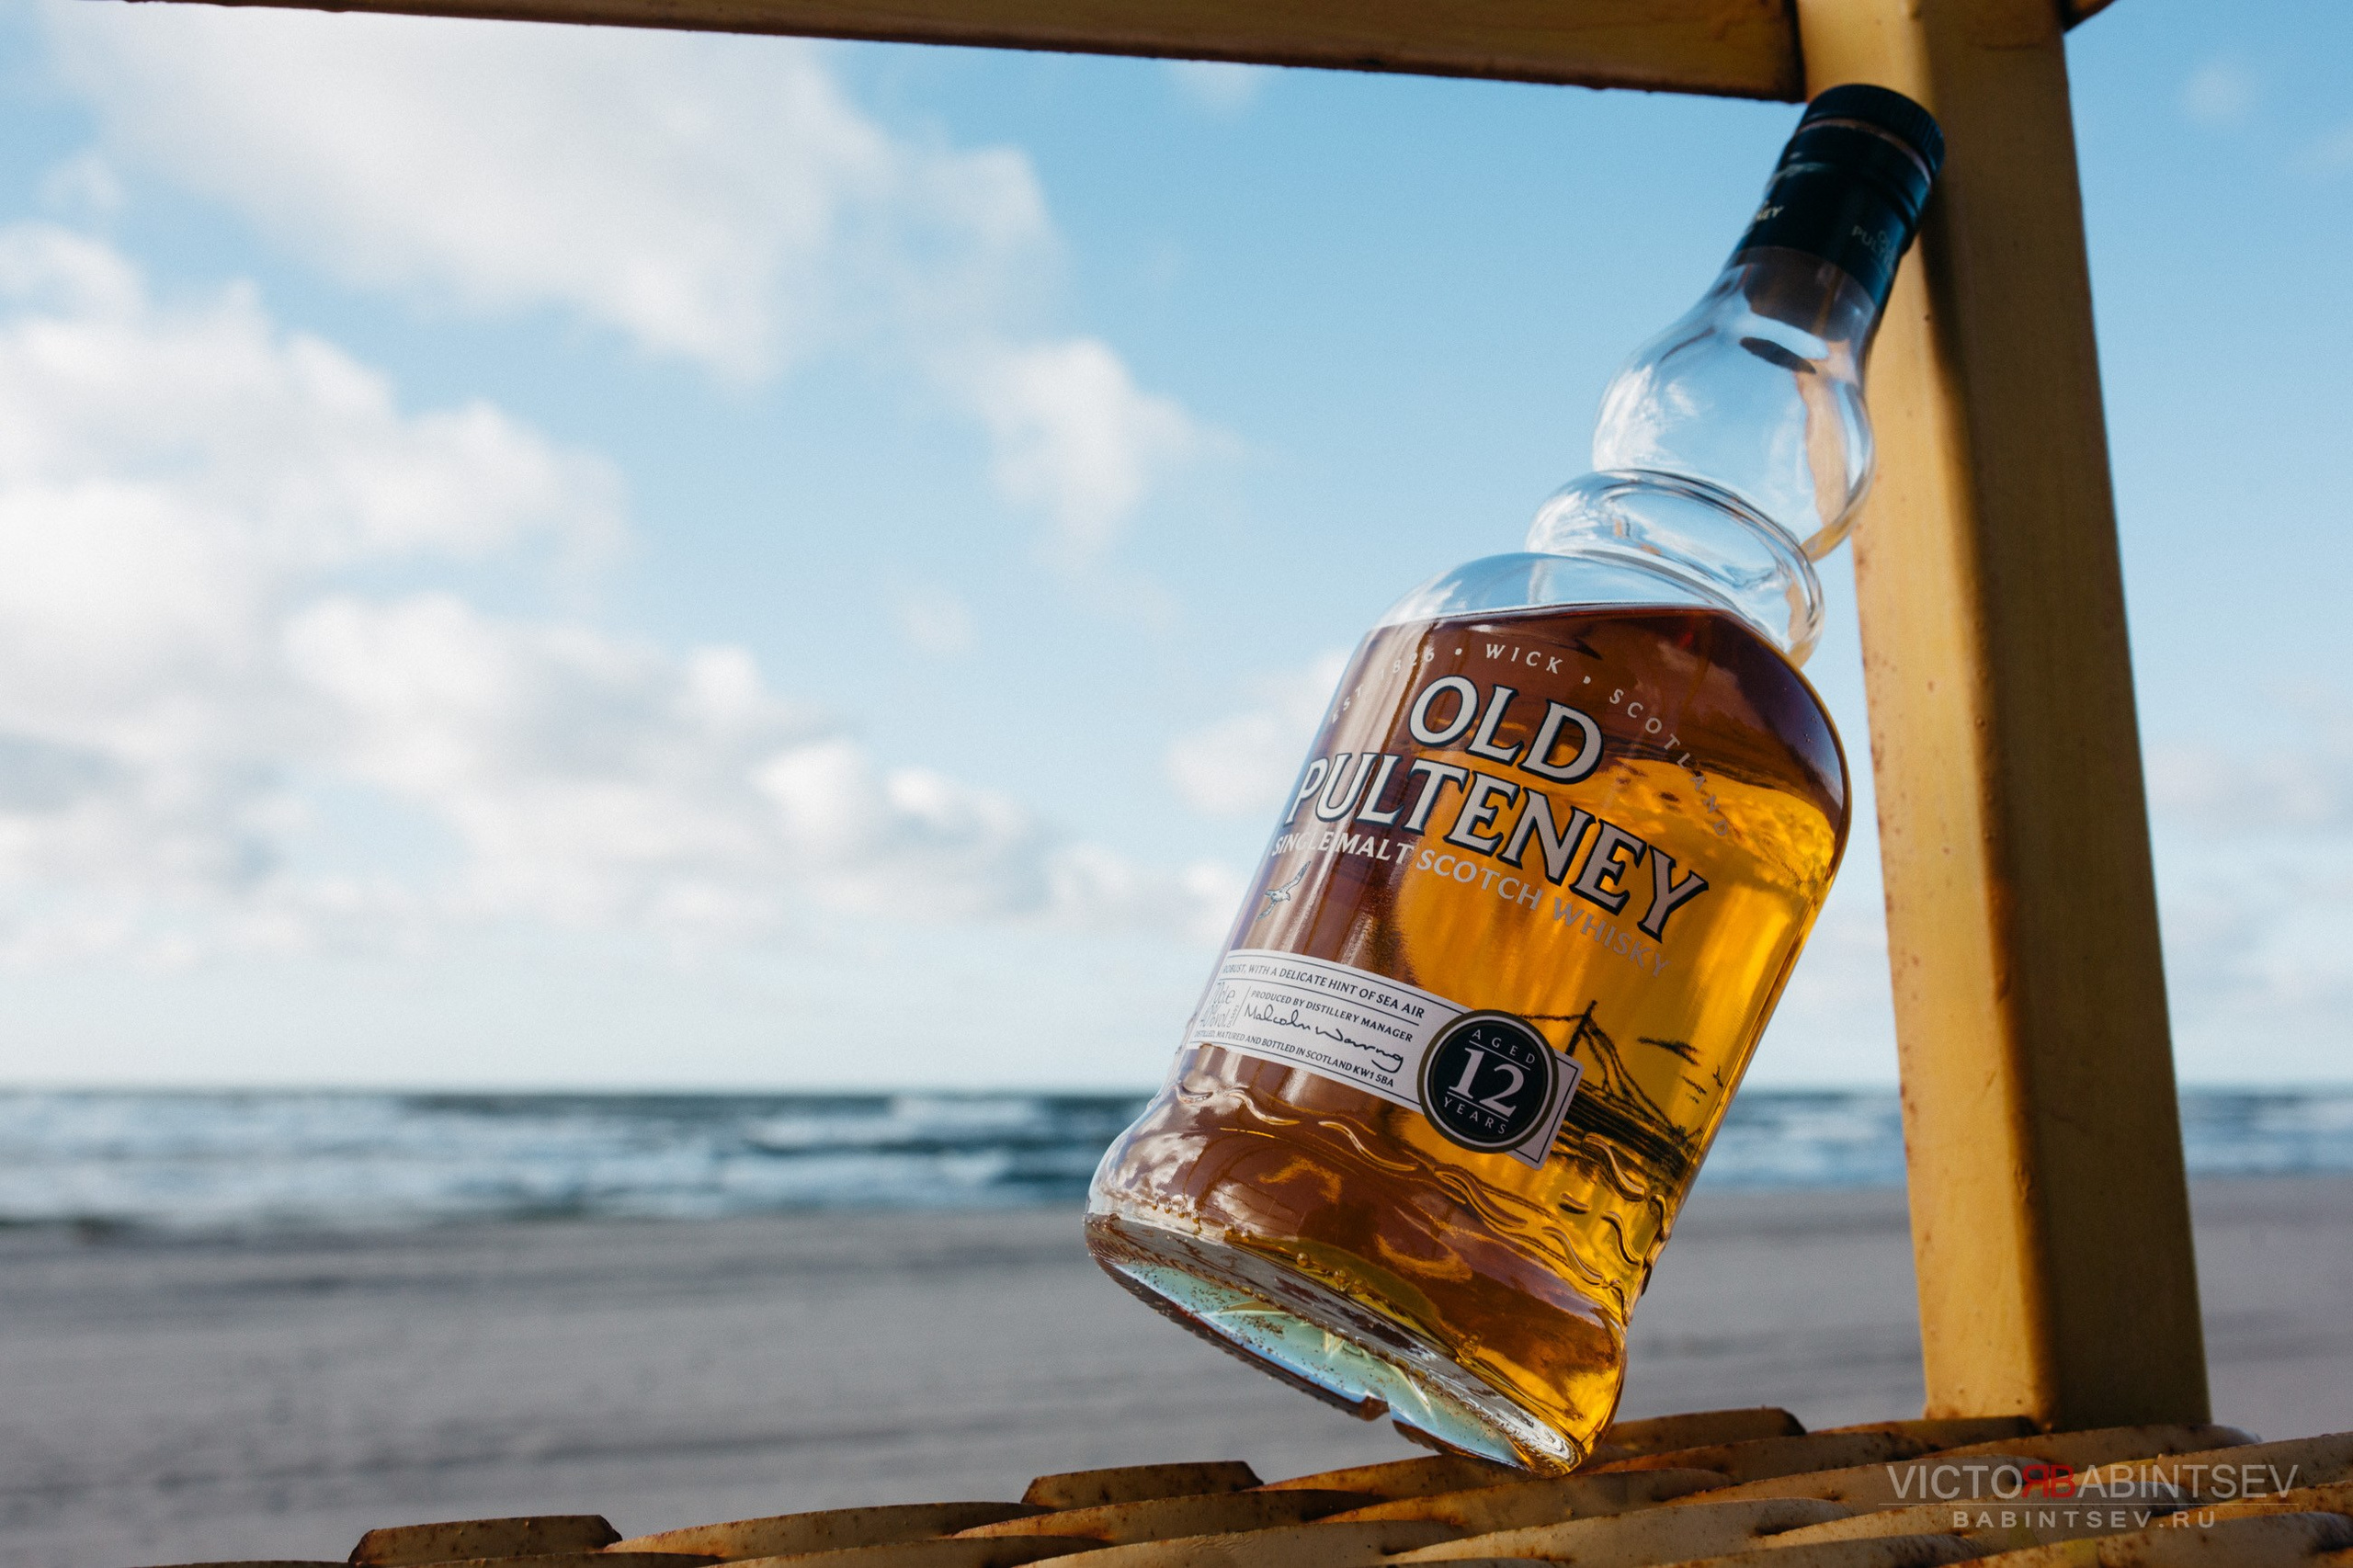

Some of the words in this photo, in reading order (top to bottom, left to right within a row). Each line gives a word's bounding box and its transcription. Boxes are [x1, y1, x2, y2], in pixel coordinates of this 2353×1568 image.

[1409, 676, 1605, 784] OLD
[1486, 643, 1563, 675] WICK
[1608, 688, 1729, 836] SCOTLAND
[1283, 753, 1709, 944] PULTENEY
[1271, 831, 1334, 857] SINGLE
[1335, 832, 1415, 865] MALT
[1415, 848, 1544, 912] SCOTCH
[1554, 897, 1671, 978] WHISKY
[1247, 964, 1270, 976] WITH
[1269, 967, 1279, 977] A
[1279, 968, 1327, 987] DELICATE
[1327, 979, 1358, 995] HINT
[1358, 988, 1377, 1001] OF
[1376, 994, 1398, 1010] SEA
[1401, 1003, 1425, 1018] AIR
[1251, 990, 1292, 1005] PRODUCED
[1292, 997, 1305, 1008] BY
[1305, 1000, 1360, 1024] DISTILLERY
[1360, 1017, 1413, 1042] MANAGER
[1216, 1030, 1245, 1041] MATURED
[1245, 1035, 1262, 1045] AND
[1262, 1038, 1296, 1053] BOTTLED
[1295, 1046, 1306, 1056] IN
[1305, 1050, 1353, 1072] SCOTLAND
[1352, 1064, 1374, 1080] KW1
[1472, 1028, 1536, 1064] AGED
[1449, 1048, 1524, 1118] 12
[1444, 1096, 1506, 1135] YEARS
